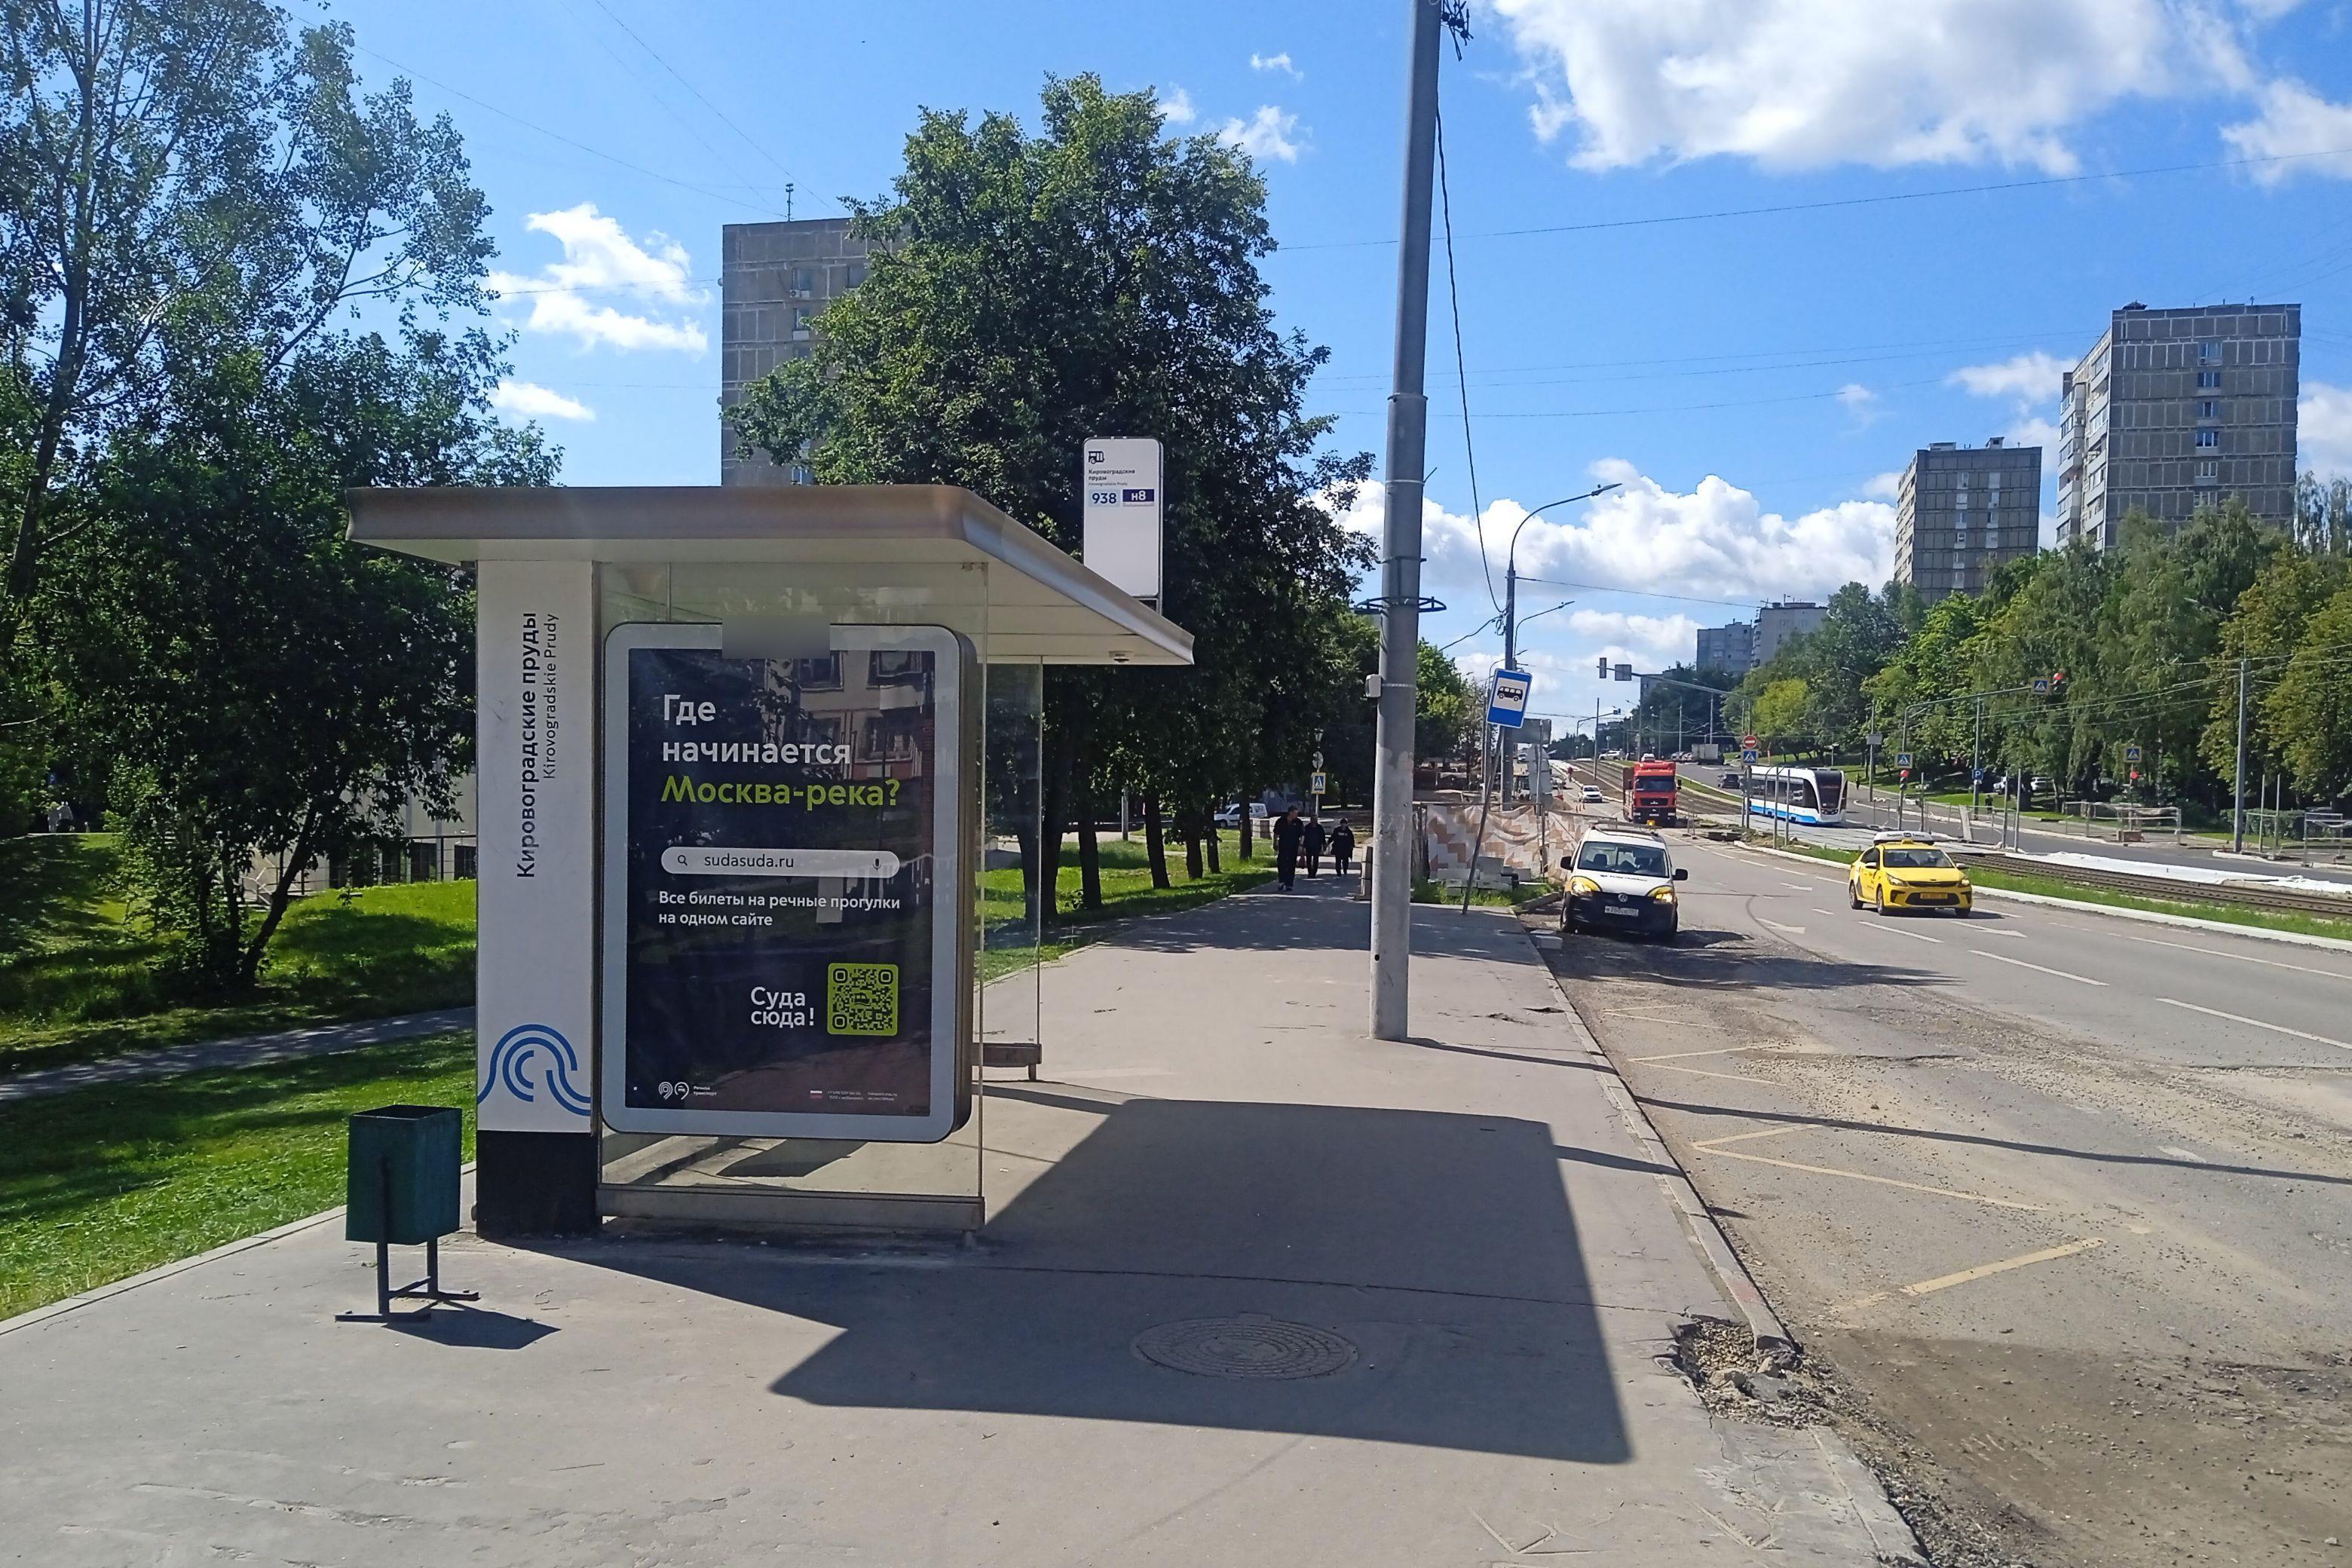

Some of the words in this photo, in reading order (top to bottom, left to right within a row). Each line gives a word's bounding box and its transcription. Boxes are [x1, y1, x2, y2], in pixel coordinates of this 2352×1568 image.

[1092, 492, 1117, 504] 938
[522, 612, 541, 684] пруды
[544, 614, 559, 658] Prudy
[544, 663, 559, 779] Kirovogradskie
[663, 694, 715, 726] Где
[662, 741, 851, 764] начинается
[516, 691, 540, 877] Кировоградские
[661, 775, 900, 811] Москва-река?
[703, 853, 795, 868] sudasuda.ru
[659, 891, 685, 904] Все
[689, 891, 744, 906] билеты
[749, 895, 766, 906] на
[769, 896, 827, 909] речные
[831, 896, 900, 911] прогулки
[658, 914, 676, 924] на
[679, 914, 728, 926] одном
[731, 912, 773, 926] сайте
[750, 986, 806, 1010] Суда
[750, 1007, 814, 1028] сюда!
